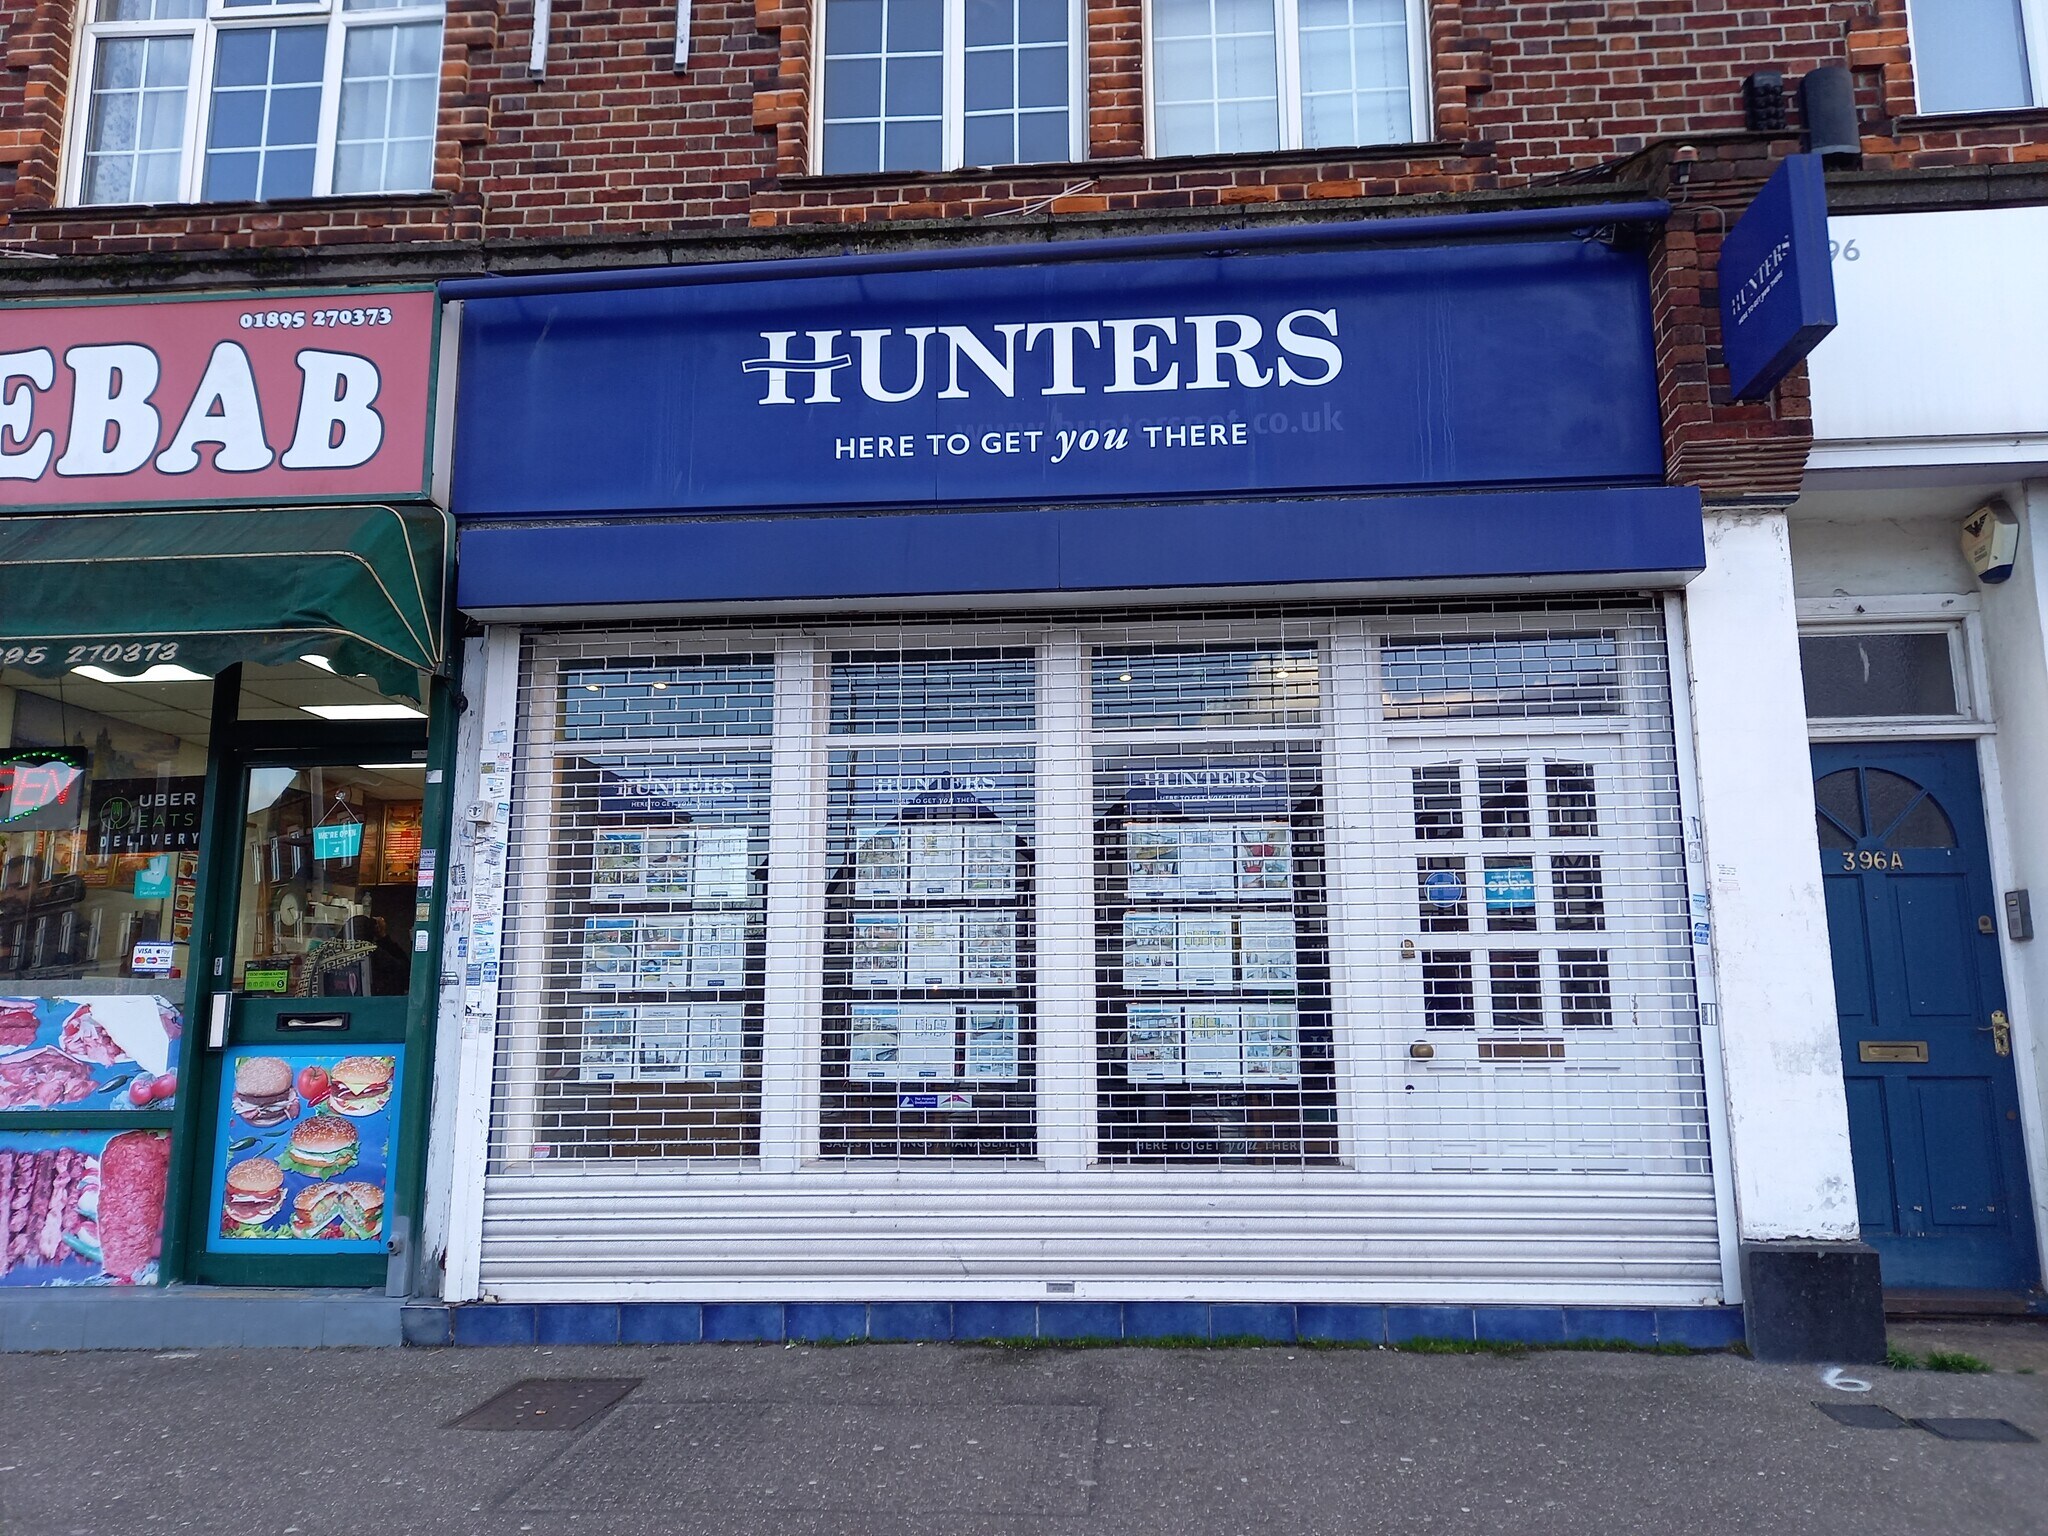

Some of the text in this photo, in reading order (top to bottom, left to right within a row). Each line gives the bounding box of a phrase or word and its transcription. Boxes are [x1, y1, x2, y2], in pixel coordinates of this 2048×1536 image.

[1731, 240, 1791, 316] HUNTERS
[239, 308, 393, 330] 01895 270373
[742, 308, 1343, 406] HUNTERS
[834, 423, 1249, 463] HERE TO GET you THERE
[64, 641, 179, 665] 270373
[613, 777, 736, 796] HUNTERS
[873, 776, 996, 792] HUNTERS
[1139, 770, 1269, 788] HUNTERS
[138, 792, 197, 808] UBER
[139, 812, 194, 829] EATS
[99, 832, 200, 848] DELIVERY
[339, 829, 357, 839] OPEN
[1842, 850, 1905, 871] 396A
[1487, 879, 1532, 896] open
[1264, 1140, 1301, 1150] THER
